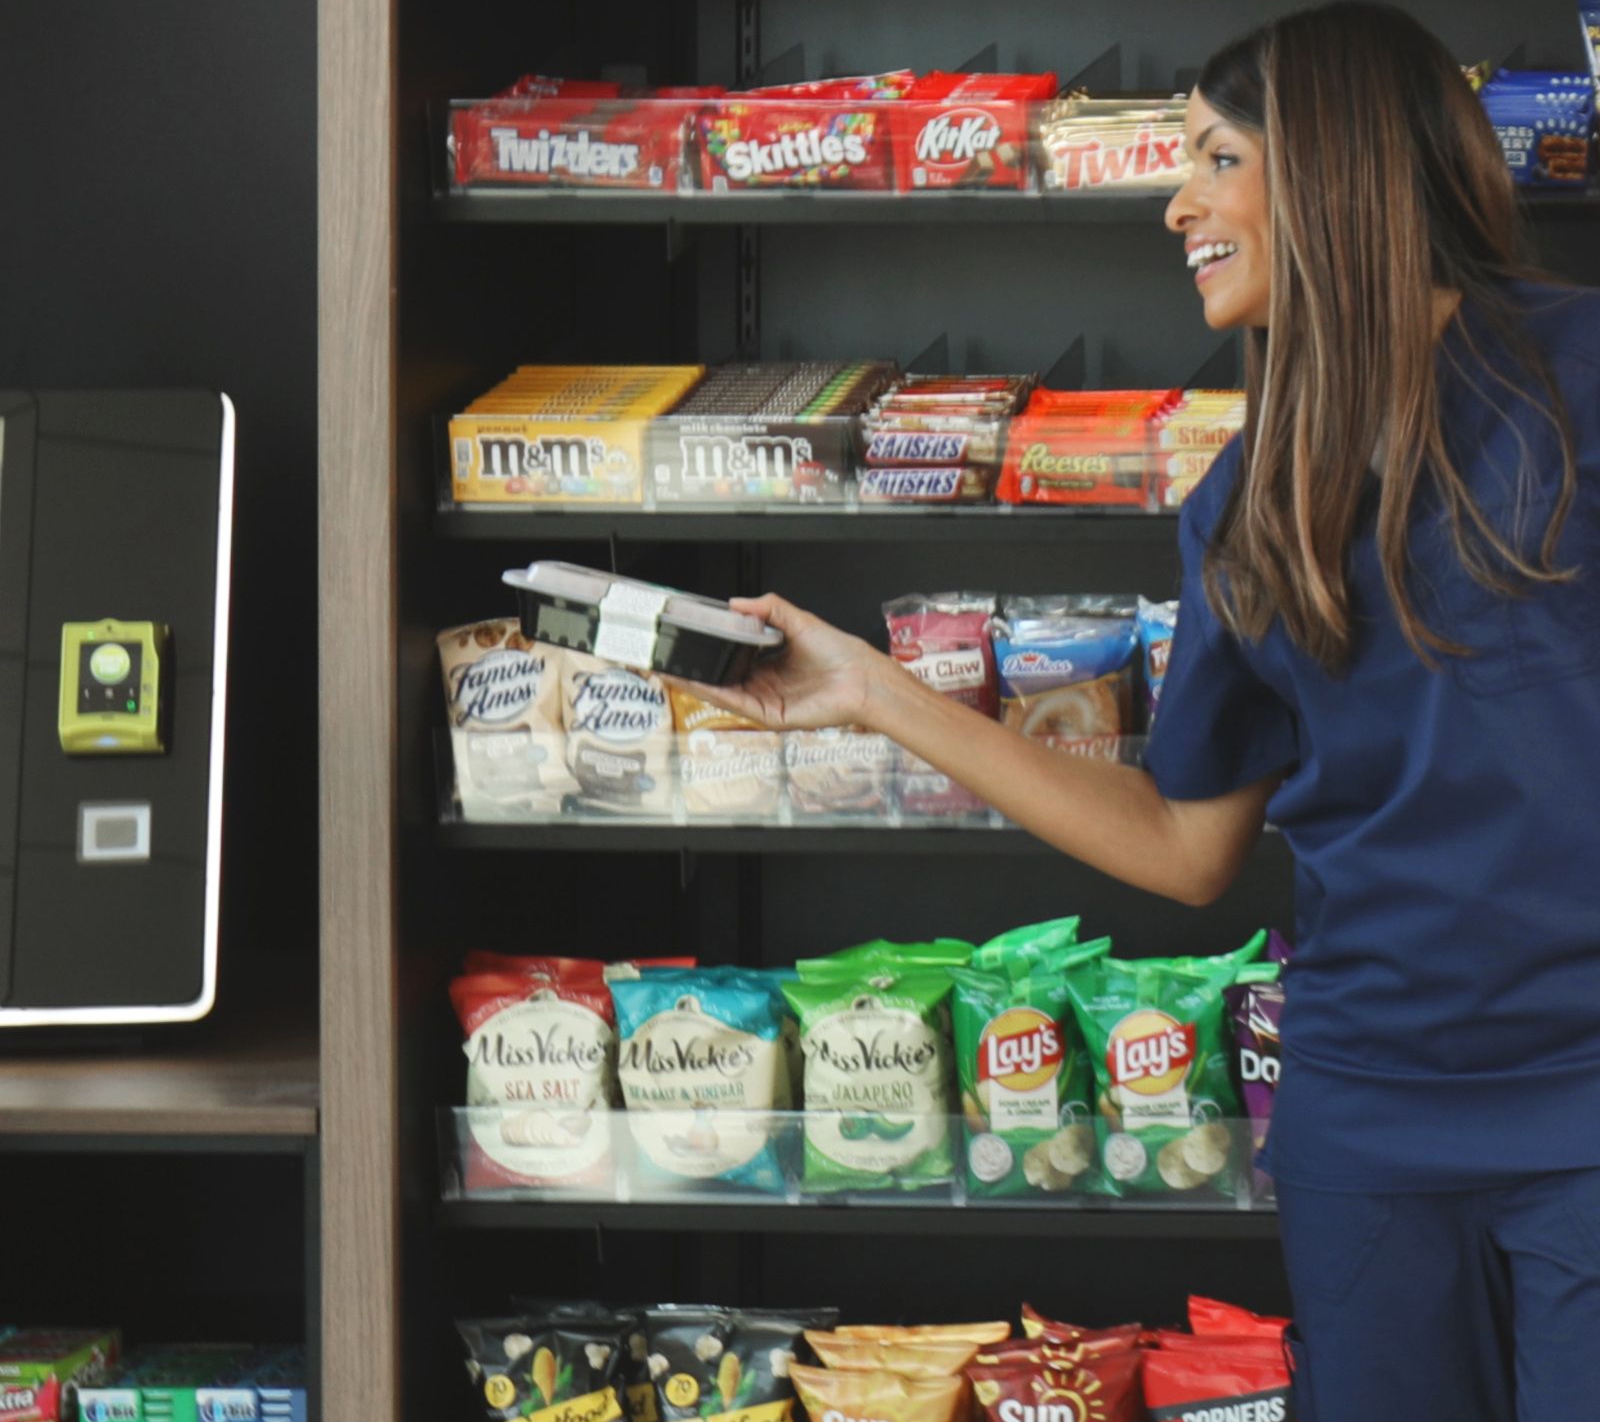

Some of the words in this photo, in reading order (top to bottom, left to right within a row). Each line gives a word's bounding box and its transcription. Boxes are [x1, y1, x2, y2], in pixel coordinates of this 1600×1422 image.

[725, 130, 867, 179] Skittles
[1054, 122, 1184, 190] Twix
[866, 434, 963, 461] SATISFIES
[1020, 442, 1113, 476] Reese's
[861, 469, 960, 497] SATISFIES
[449, 656, 546, 702] Famous
[936, 660, 981, 677] Claw
[1001, 658, 1071, 675] Duchess
[457, 681, 538, 723] Amos
[572, 674, 667, 713] Famous
[572, 703, 659, 731] Amos
[987, 1023, 1060, 1076] Lay's
[1114, 1026, 1189, 1079] Lay's
[504, 1080, 536, 1100] SEA
[542, 1078, 581, 1099] SALT
